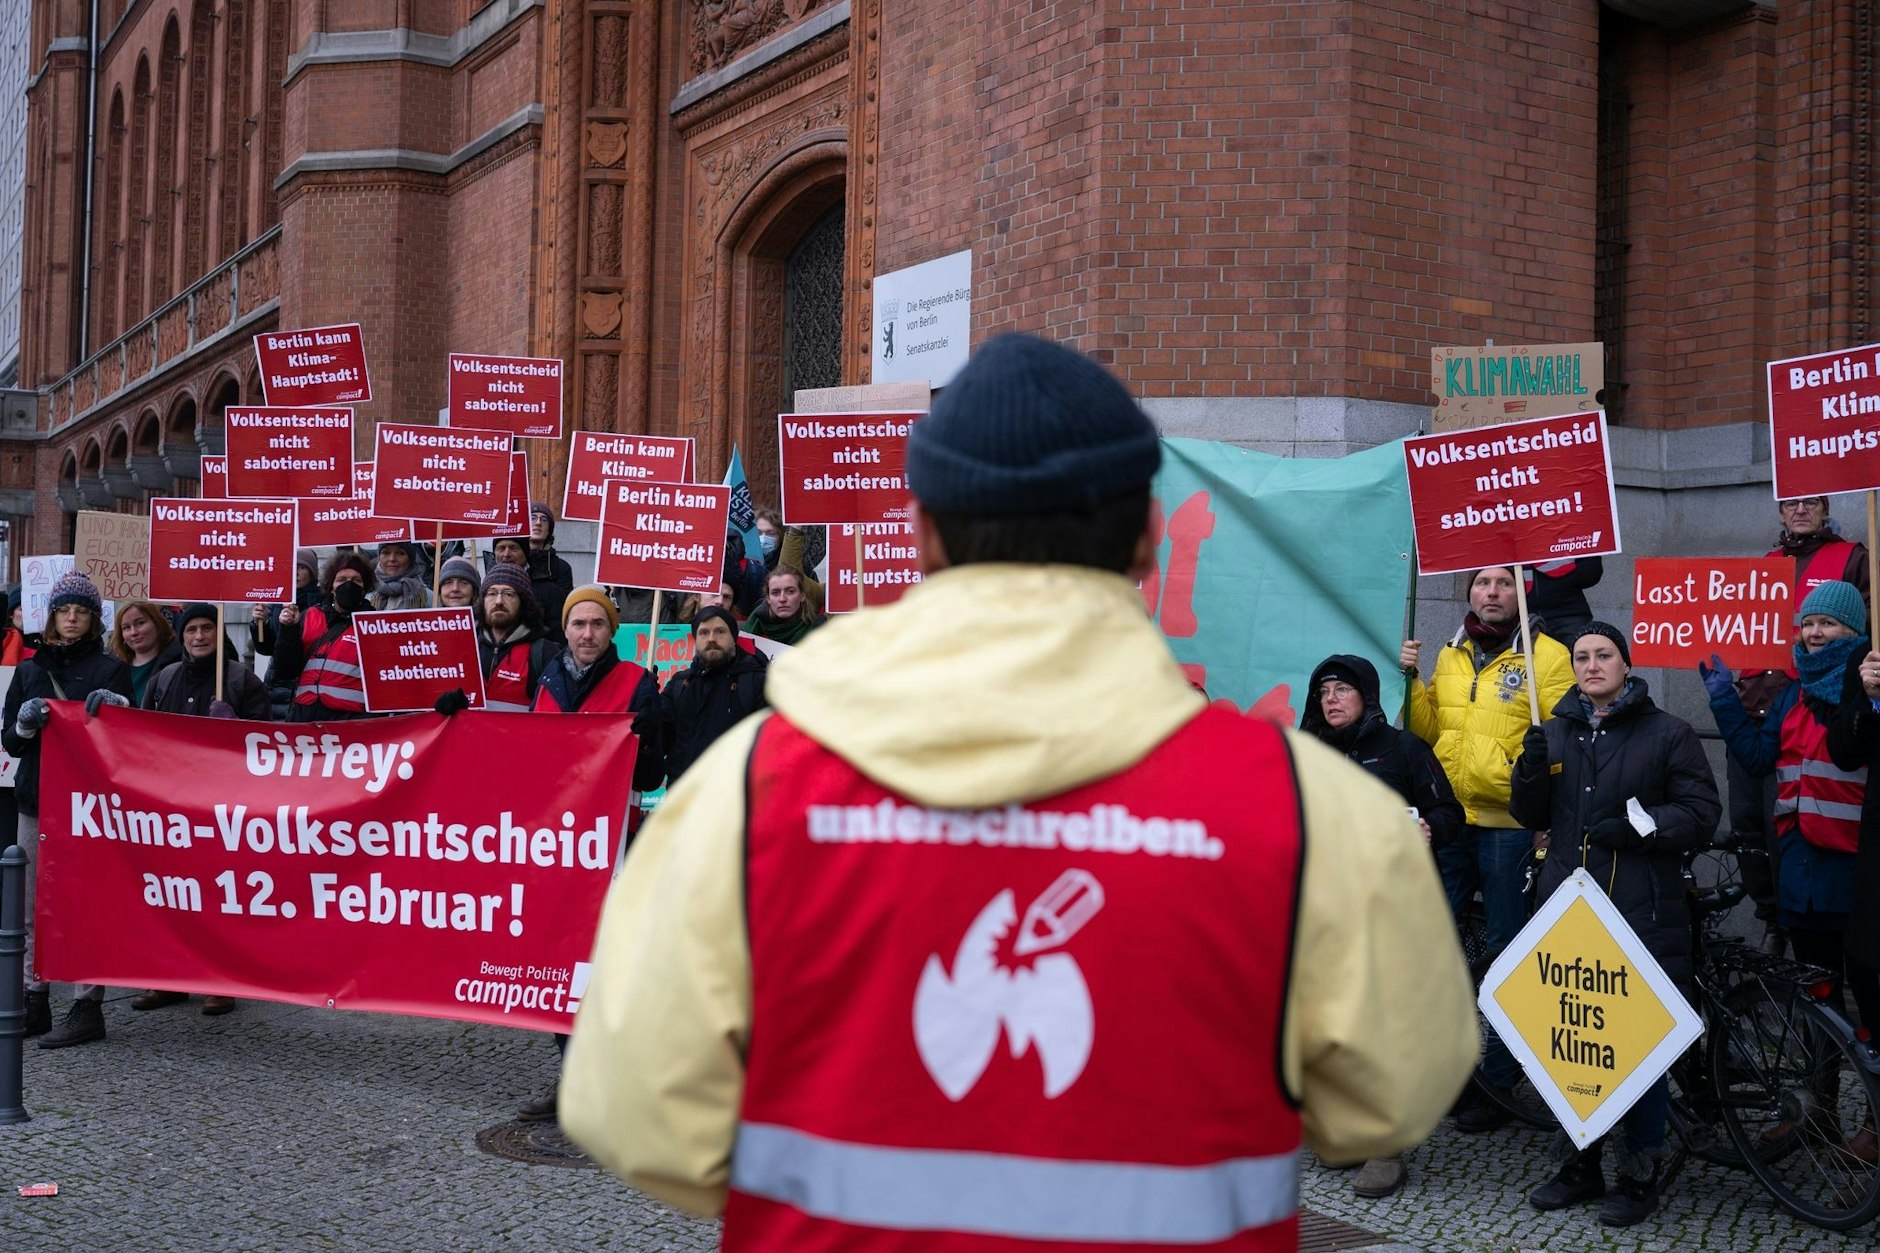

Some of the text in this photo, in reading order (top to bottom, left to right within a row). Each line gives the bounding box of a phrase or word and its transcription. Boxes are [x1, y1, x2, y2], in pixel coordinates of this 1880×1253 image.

[907, 301, 917, 313] Die
[919, 291, 954, 312] Regierende
[907, 314, 938, 330] von Berlin
[267, 332, 351, 350] Berlin kann
[906, 336, 949, 356] Senatskanzlei
[288, 352, 337, 367] Klima-
[453, 360, 559, 377] Volksentscheid
[271, 367, 359, 388] Hauptstadt!
[1444, 353, 1589, 398] KLIMAWAHL
[1789, 357, 1868, 390] Berlin
[488, 380, 525, 393] nicht
[464, 398, 546, 414] sabotieren!
[229, 413, 349, 428] Volksentscheid
[785, 419, 915, 439] Volksentschei
[269, 434, 311, 448] nicht
[382, 429, 509, 451] Volksentscheid
[585, 437, 675, 458] Berlin kann
[1410, 421, 1597, 468] Volksentscheid
[1789, 428, 1880, 459] Haupts
[244, 455, 335, 470] sabotieren!
[422, 454, 467, 471] nicht
[833, 446, 881, 464] nicht
[601, 460, 654, 478] Klima-
[1476, 465, 1540, 492] nicht
[393, 475, 491, 495] sabotieren!
[803, 473, 910, 490] sabotieren!
[618, 485, 716, 509] Berlin kann
[156, 505, 292, 524] Volksentscheid
[730, 511, 749, 529] Berlin
[882, 510, 914, 519] campac
[1440, 491, 1583, 530] sabotieren!
[81, 517, 114, 536] UND
[636, 513, 693, 534] Klima-
[85, 538, 125, 557] EUCH
[200, 530, 247, 547] nicht
[1550, 531, 1601, 552] campact!
[610, 538, 714, 564] Hauptstadt!
[169, 554, 274, 572] sabotieren!
[104, 578, 148, 599] BLOCK
[1708, 569, 1789, 602] Berlin
[358, 614, 471, 635] Volksentscheid
[1633, 611, 1787, 648] eine WAHL
[399, 640, 438, 656] nicht
[379, 662, 466, 681] sabotieren!
[245, 730, 416, 793] Giffey:
[70, 791, 610, 871] Klima-Volksentscheid
[806, 797, 1225, 861] unterschreiben.
[143, 870, 525, 938] am 12. Februar!
[480, 960, 570, 982] Bewegt Politik
[1537, 951, 1629, 997] Vorfahrt
[454, 961, 593, 1014] campact!
[1559, 992, 1605, 1031] fürs
[1550, 1026, 1616, 1070] Klima
[1567, 1084, 1602, 1097] campact!
